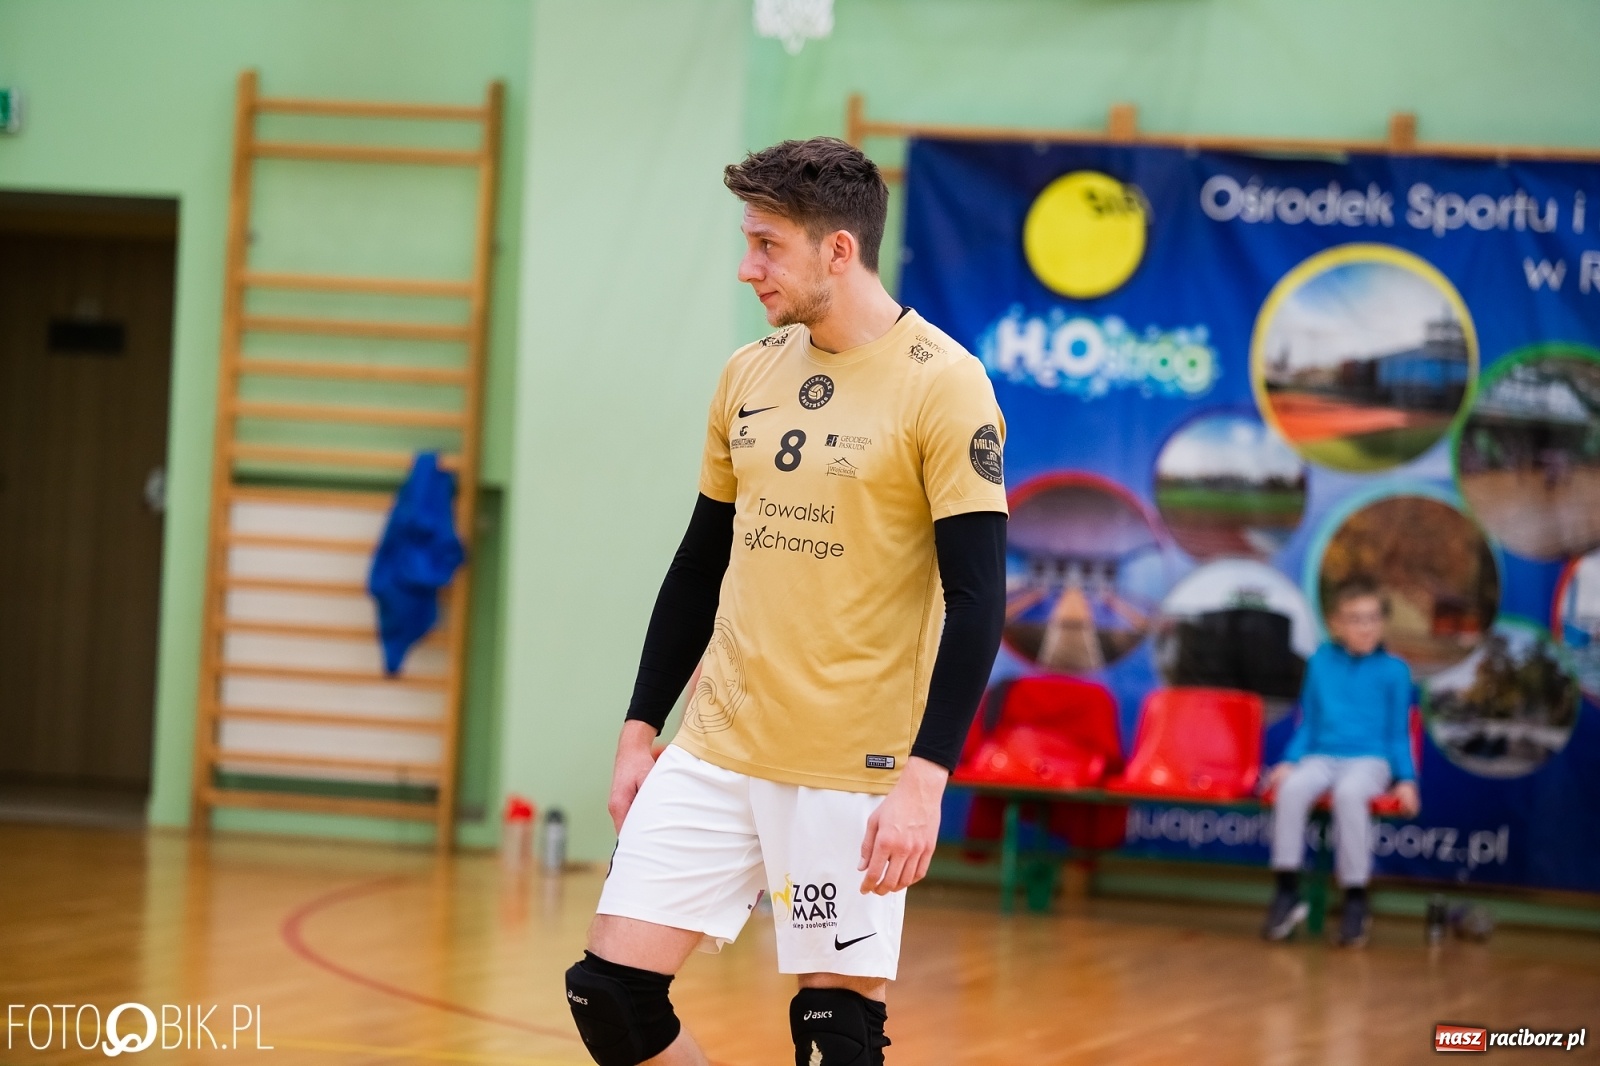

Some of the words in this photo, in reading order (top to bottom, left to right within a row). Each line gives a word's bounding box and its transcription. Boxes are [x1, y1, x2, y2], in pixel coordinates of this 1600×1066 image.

[1201, 175, 1394, 228] Ośrodek
[1406, 182, 1558, 238] Sportu
[1573, 190, 1586, 234] i
[774, 428, 807, 472] 8
[758, 497, 836, 525] Towalski
[792, 882, 837, 903] ZOO
[792, 901, 838, 921] MAR
[811, 1010, 833, 1019] asics
